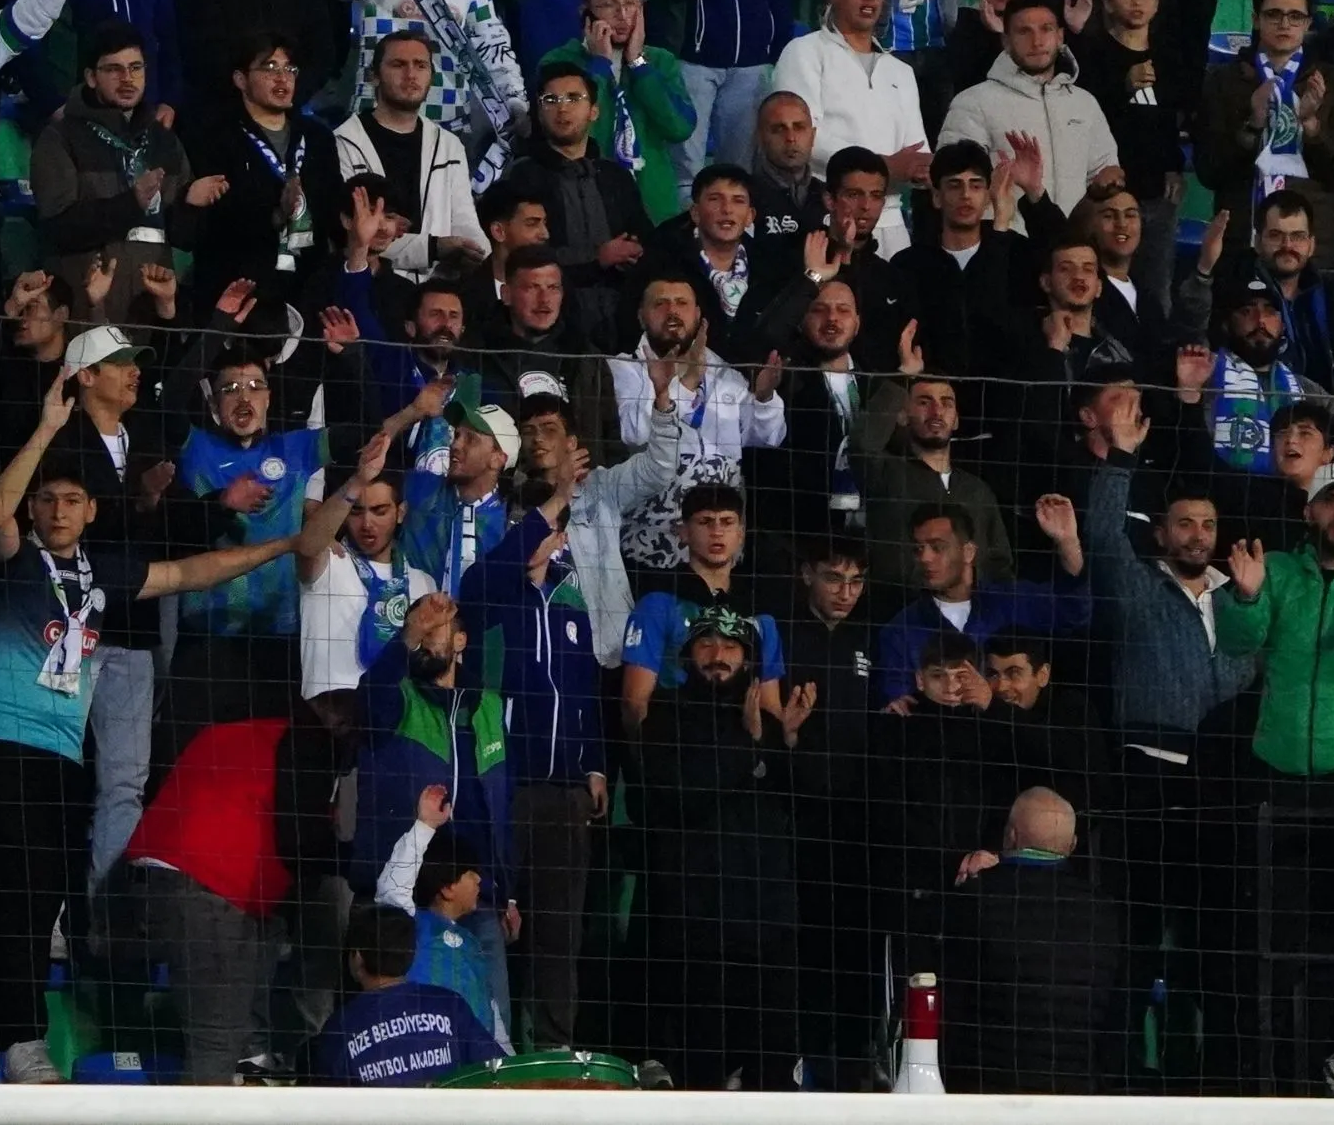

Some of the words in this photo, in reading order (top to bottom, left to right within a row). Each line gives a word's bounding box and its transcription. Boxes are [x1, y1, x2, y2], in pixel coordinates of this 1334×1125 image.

[764, 214, 800, 235] RS
[348, 1024, 374, 1060] RİZE
[373, 1010, 454, 1043] BELEDİYESPOR
[115, 1056, 140, 1068] E-15
[359, 1052, 409, 1083] HENTBOL
[409, 1040, 453, 1074] AKADEMİ
